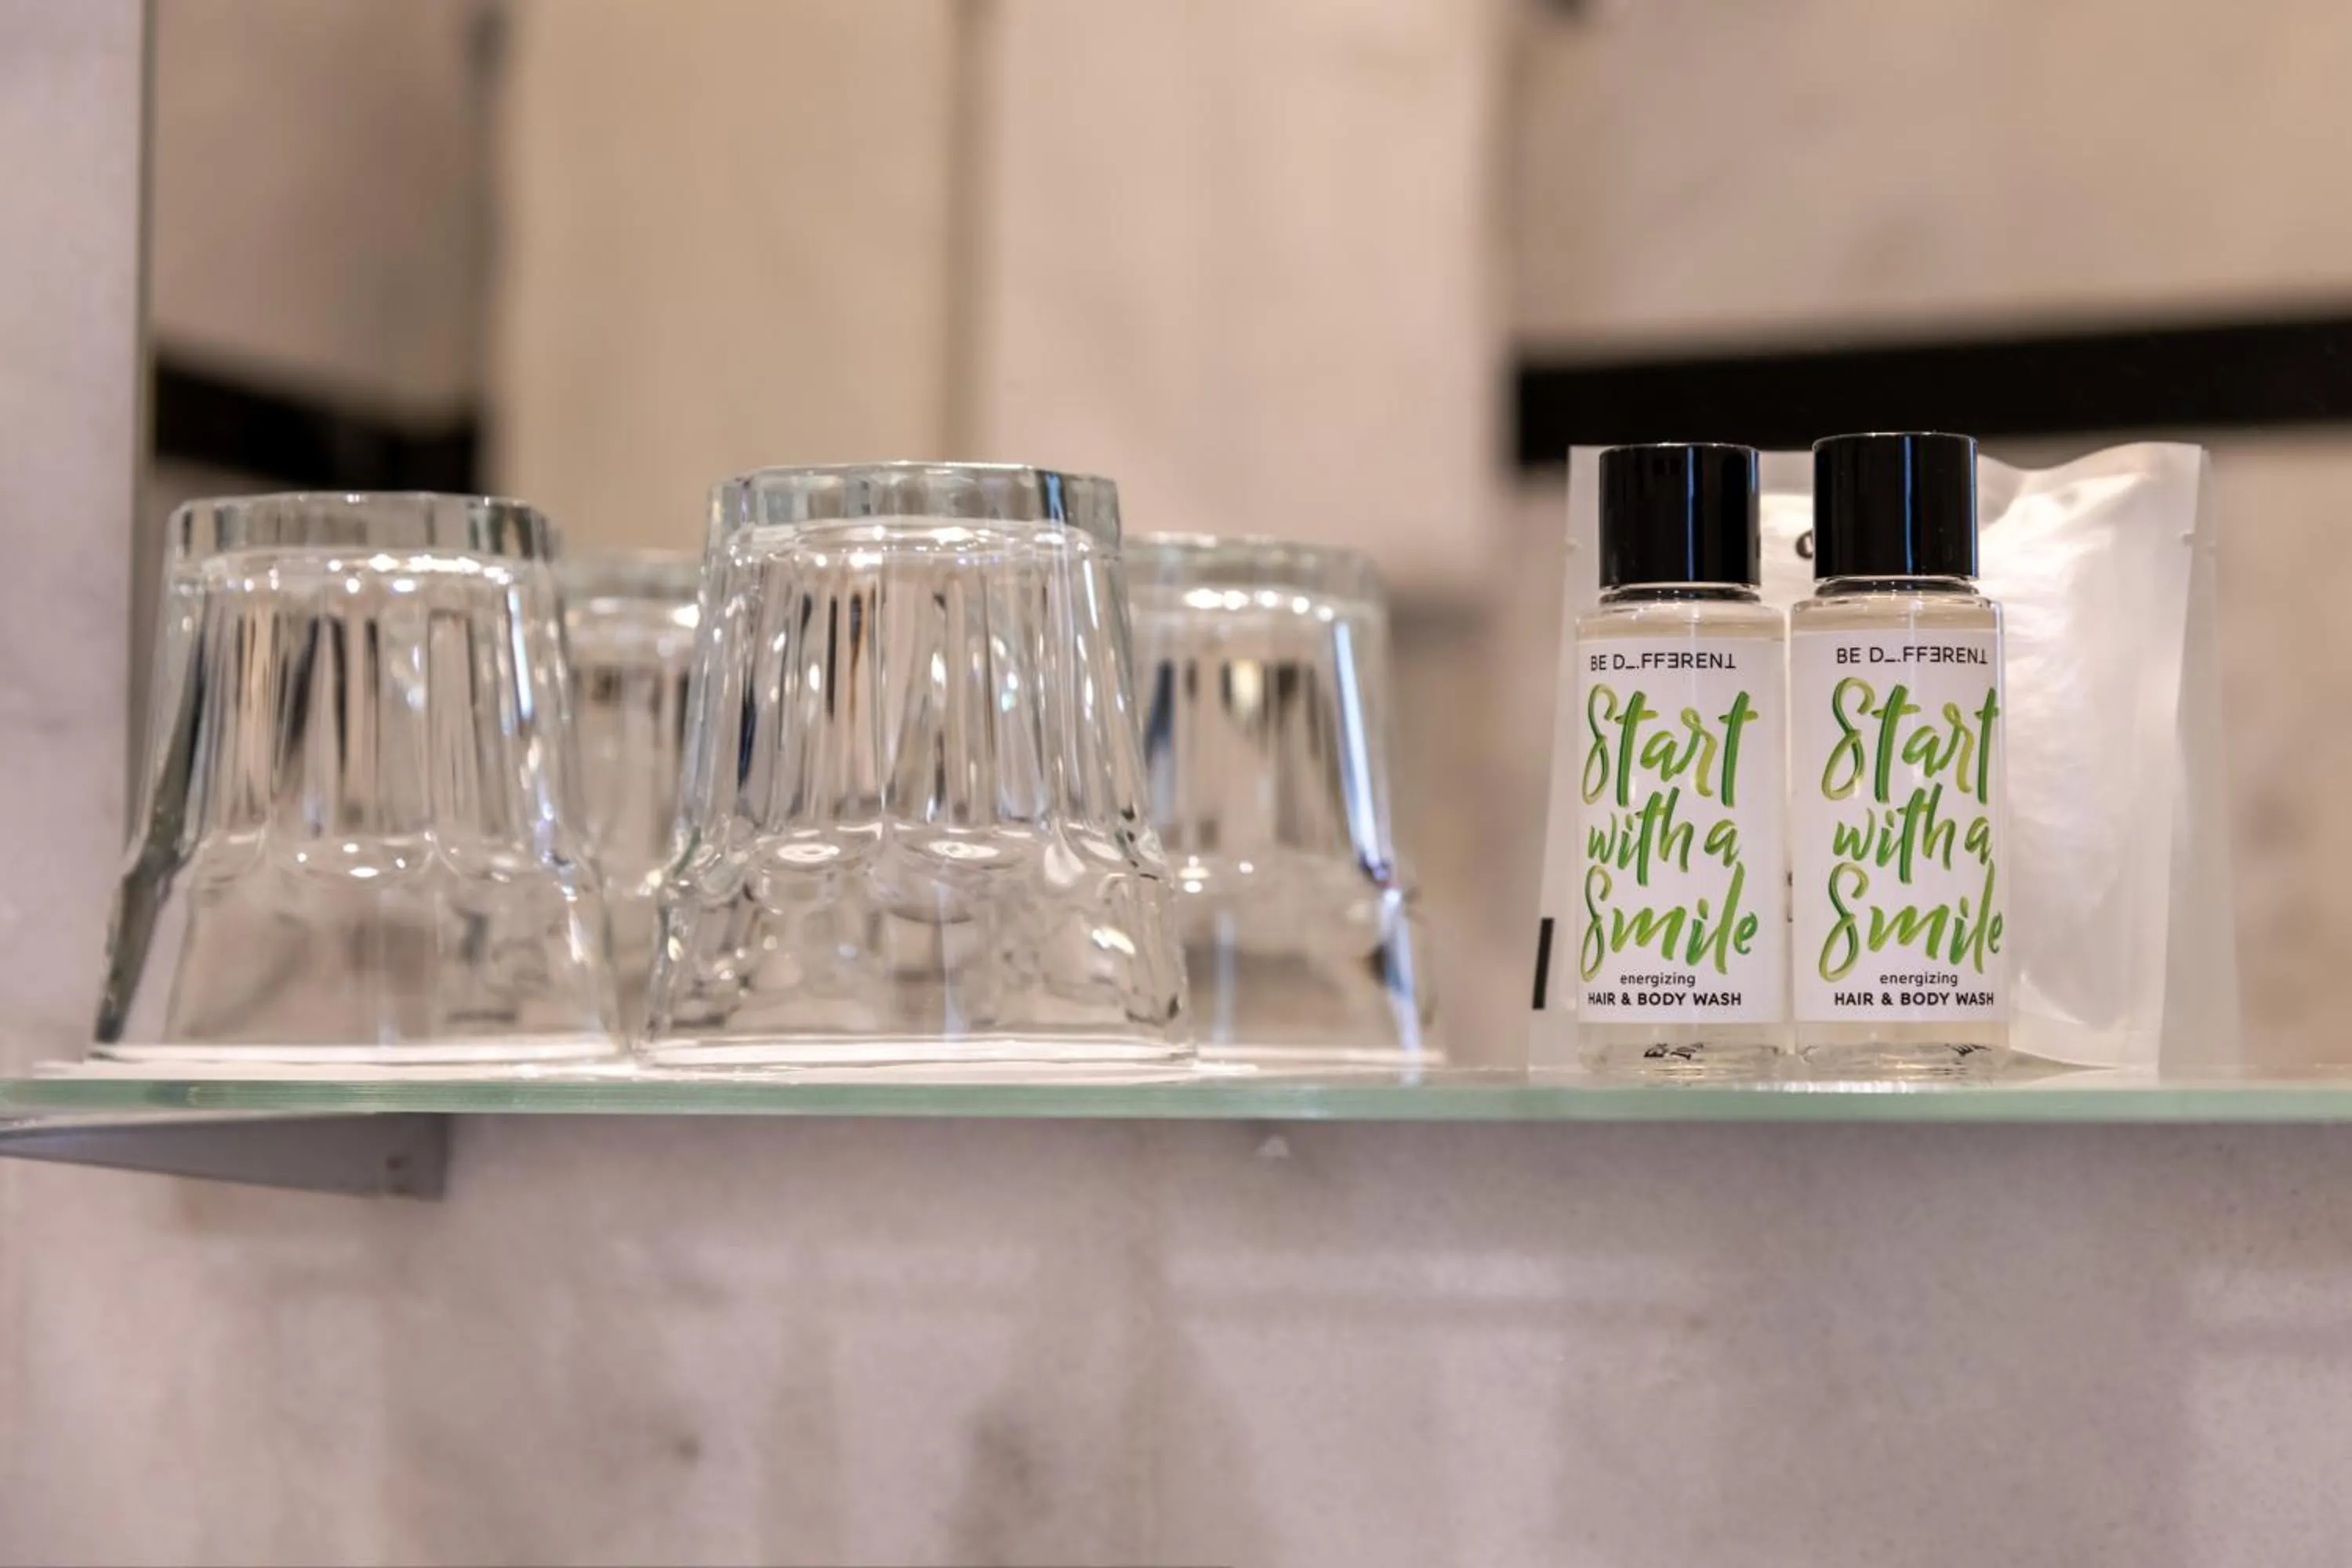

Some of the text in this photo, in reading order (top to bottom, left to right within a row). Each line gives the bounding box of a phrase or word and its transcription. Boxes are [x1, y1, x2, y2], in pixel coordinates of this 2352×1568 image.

[1590, 655, 1607, 671] BE
[1836, 647, 1861, 664] BE
[1582, 683, 1759, 808] Start
[1821, 676, 1999, 805] Start
[1588, 786, 1742, 887] with a
[1832, 782, 1992, 885] with a
[1580, 861, 1759, 982] Smile
[1818, 858, 2004, 983] Smile
[1588, 992, 1742, 1006] HAIR & BODY WASH
[1619, 971, 1697, 988] energizing
[1833, 992, 1995, 1006] HAIR & BODY WASH
[1878, 971, 1959, 987] energizing
